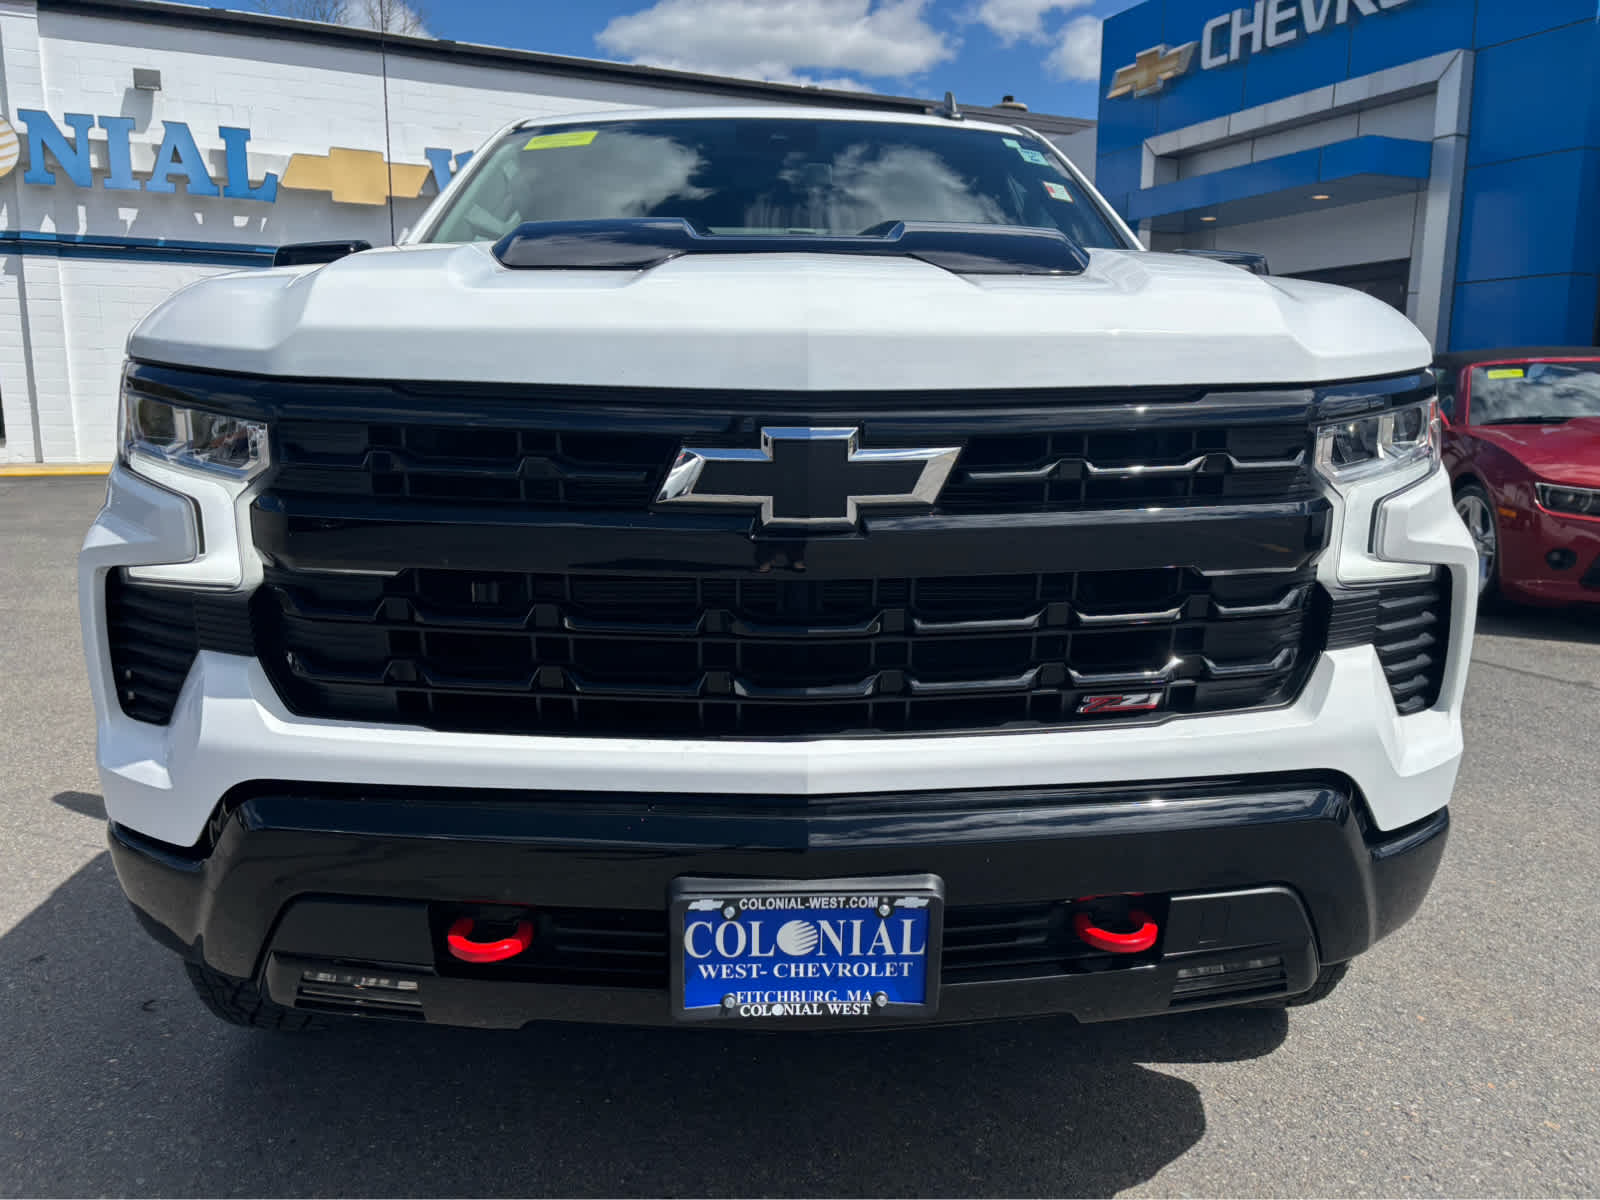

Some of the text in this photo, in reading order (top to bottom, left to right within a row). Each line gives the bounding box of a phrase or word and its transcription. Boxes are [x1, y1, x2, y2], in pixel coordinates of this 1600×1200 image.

[738, 896, 879, 910] COLONIAL-WEST.COM
[684, 918, 926, 959] COLONIAL
[698, 962, 914, 980] WEST- CHEVROLET
[847, 990, 873, 1003] MA
[739, 1003, 872, 1017] COLONIAL WEST
